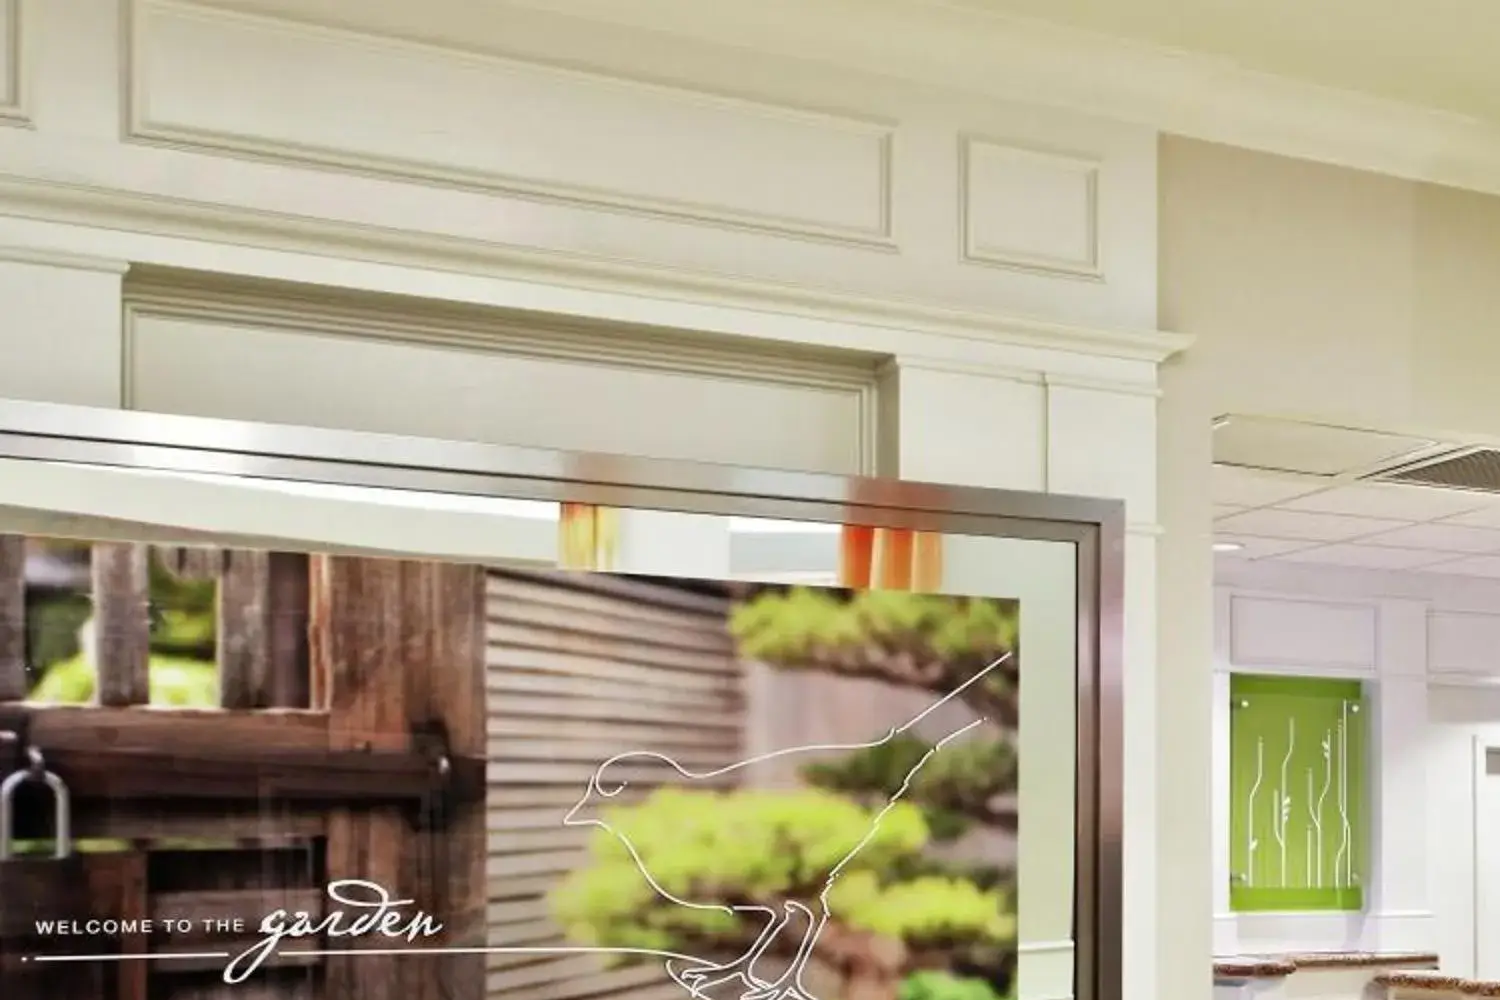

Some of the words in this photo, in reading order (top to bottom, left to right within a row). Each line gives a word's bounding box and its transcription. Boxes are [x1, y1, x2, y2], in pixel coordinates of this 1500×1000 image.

[35, 919, 153, 935] WELCOME
[162, 918, 193, 934] TO
[202, 918, 245, 934] THE
[222, 878, 444, 985] garden
